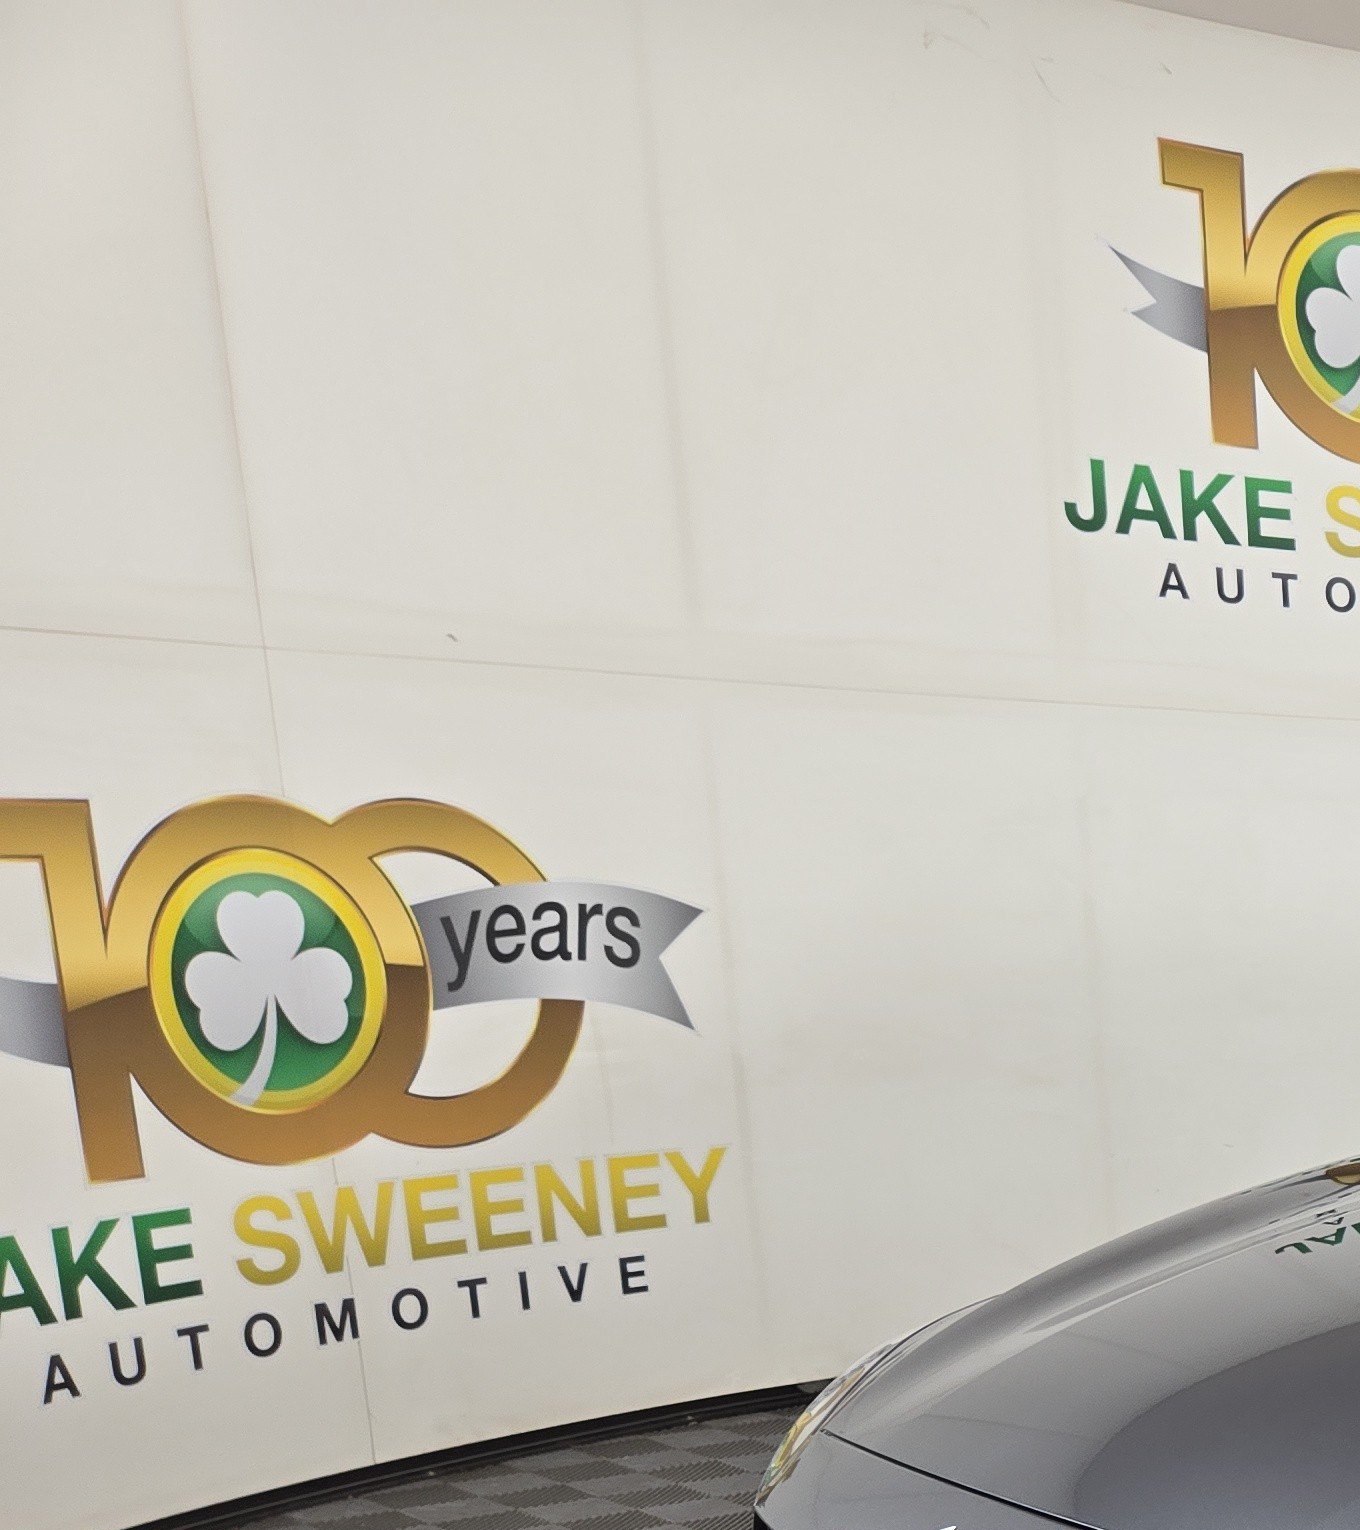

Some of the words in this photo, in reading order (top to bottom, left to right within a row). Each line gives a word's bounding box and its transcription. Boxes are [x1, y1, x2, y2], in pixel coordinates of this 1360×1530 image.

[1064, 458, 1297, 551] JAKE
[439, 901, 643, 993] years
[0, 1207, 204, 1326] AKE
[232, 1146, 728, 1287] SWEENEY
[43, 1255, 650, 1404] AUTOMOTIVE
